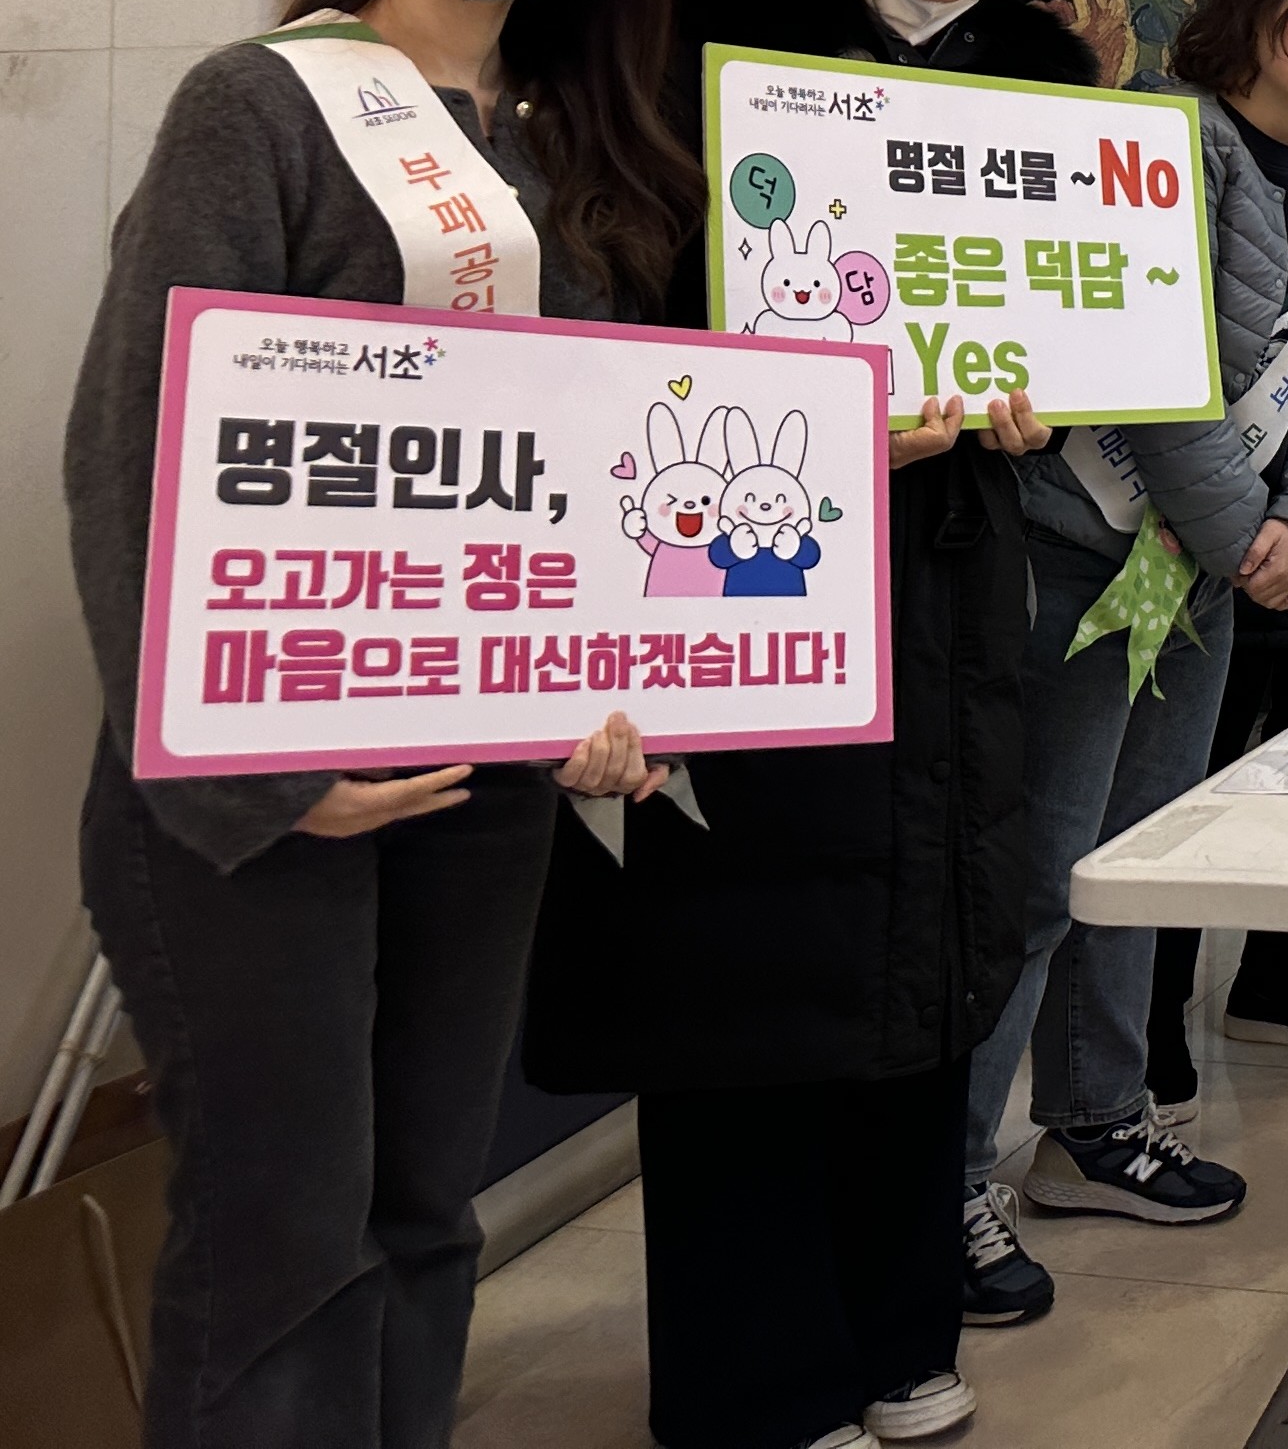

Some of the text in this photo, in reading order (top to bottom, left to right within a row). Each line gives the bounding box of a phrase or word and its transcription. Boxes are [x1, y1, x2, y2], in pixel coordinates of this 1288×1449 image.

[766, 85, 826, 101] 오늘 행복하고
[828, 92, 876, 121] 서초
[748, 165, 776, 208] 덕
[886, 138, 967, 196] 명절
[980, 147, 1058, 202] 선물
[845, 269, 875, 306] 담
[893, 232, 1007, 308] 좋은
[1024, 238, 1129, 310] 덕담
[233, 353, 350, 375] 내일이 기다려지는
[259, 338, 350, 356] 오늘 행복하고
[353, 344, 424, 380] 서초
[905, 321, 1030, 396] Yes
[214, 416, 570, 525] 명절인사,
[206, 542, 579, 612] 오고가는 정은
[201, 628, 848, 704] 마음으로 대신하겠습니다!
